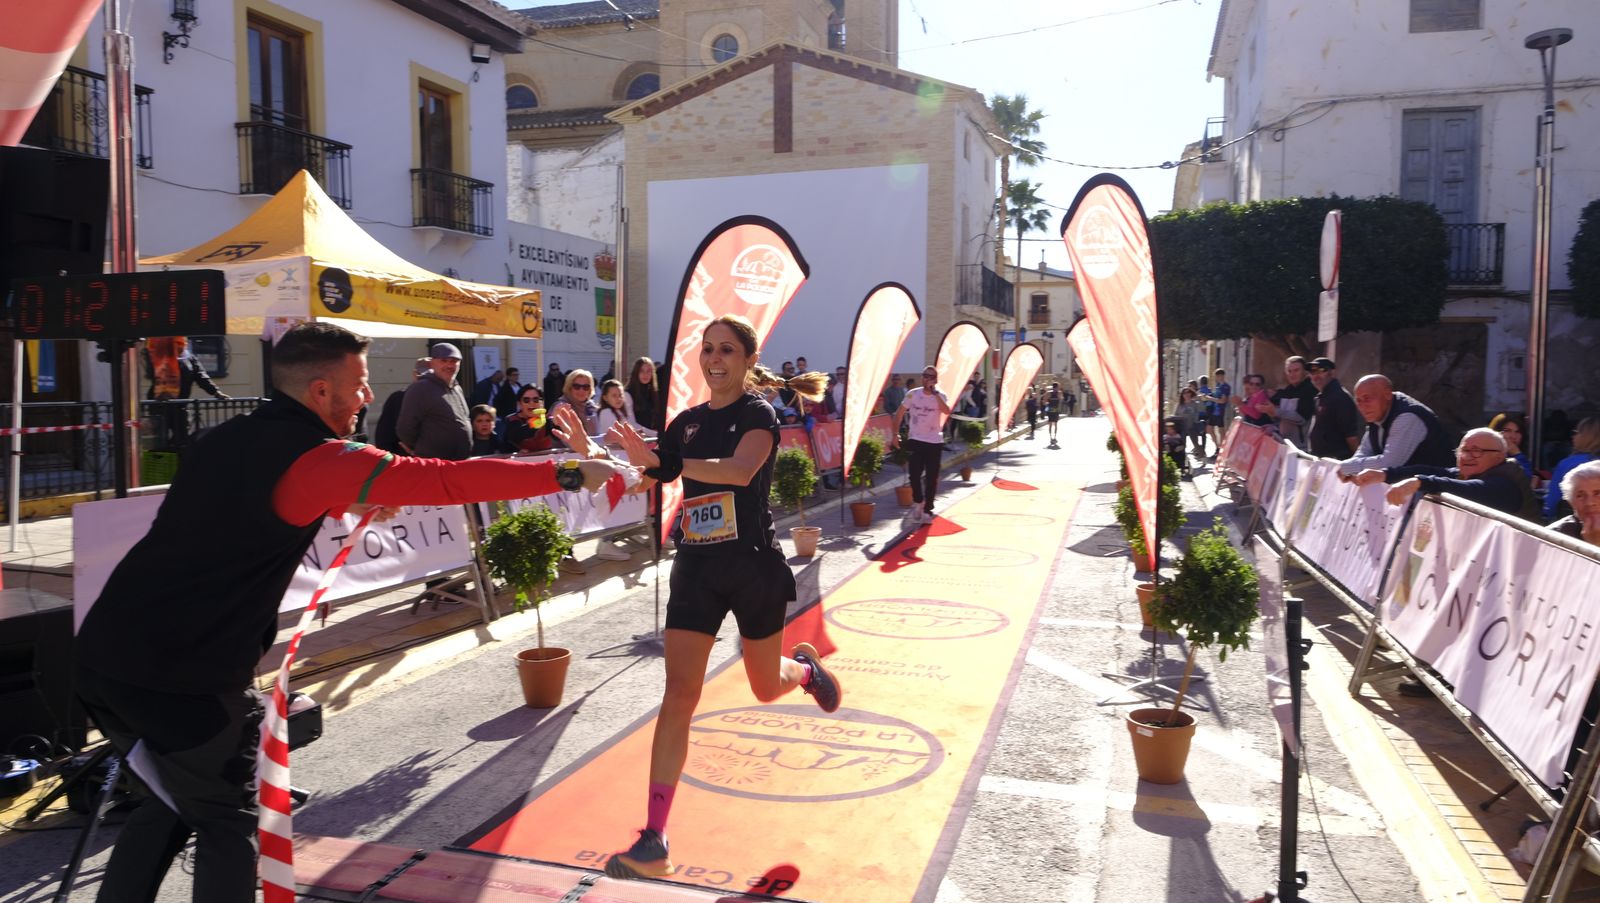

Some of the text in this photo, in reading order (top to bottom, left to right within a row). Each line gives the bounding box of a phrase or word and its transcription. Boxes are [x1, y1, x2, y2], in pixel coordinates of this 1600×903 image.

[519, 244, 589, 271] EXCELENTÍSIMO
[521, 268, 589, 292] AYUNTAMIENTO
[20, 281, 210, 333] 01:21:11
[550, 295, 562, 310] DE
[542, 317, 578, 334] ANTORIA
[692, 504, 723, 524] 160
[302, 517, 454, 573] NTORIA
[1562, 615, 1592, 651] DE
[720, 714, 915, 743] LA POLVORA
